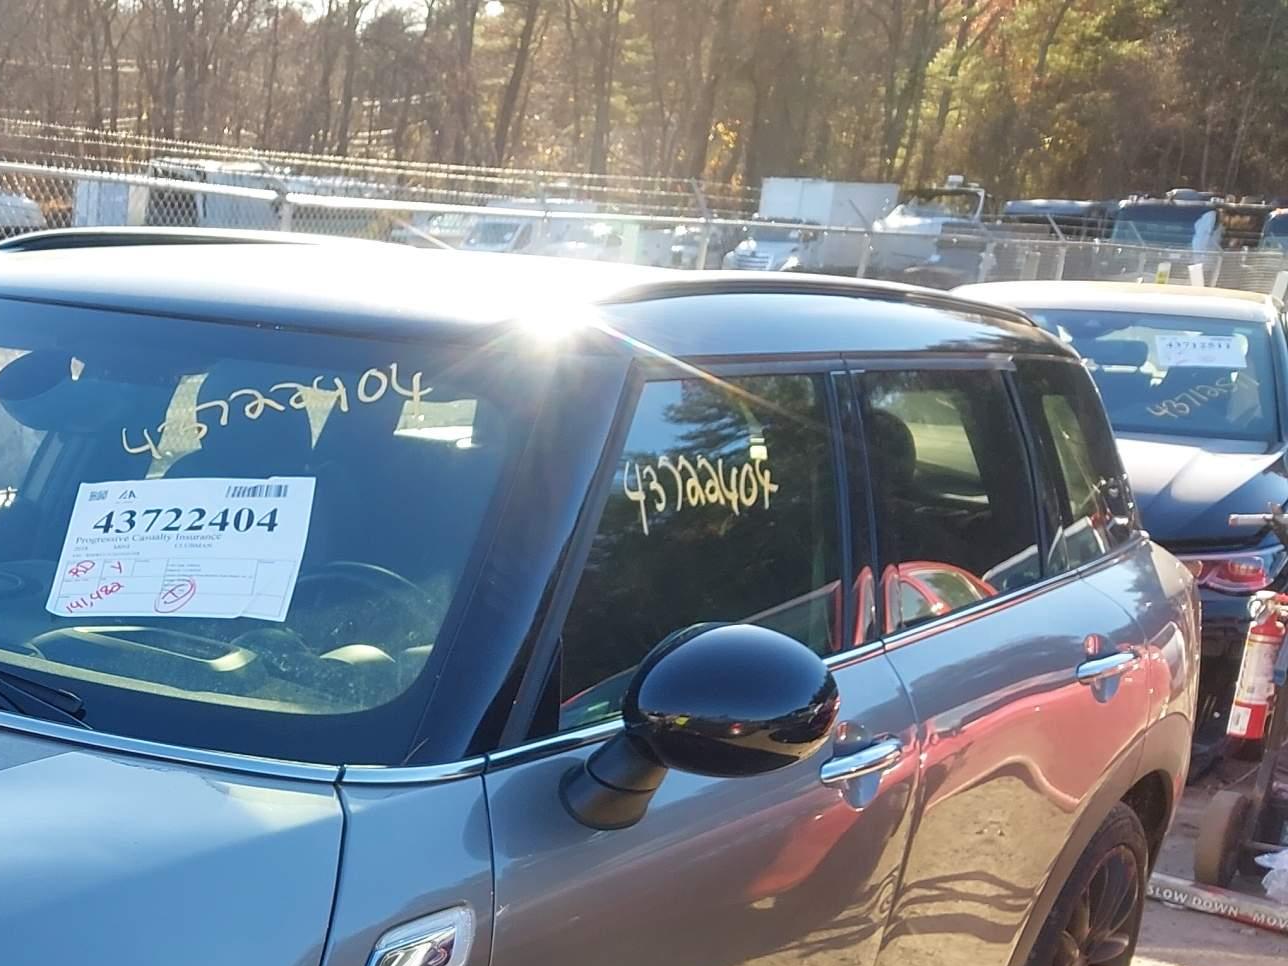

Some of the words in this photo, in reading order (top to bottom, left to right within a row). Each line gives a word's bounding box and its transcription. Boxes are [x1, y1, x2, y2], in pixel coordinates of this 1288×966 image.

[122, 363, 432, 459] 43722404
[624, 454, 779, 536] 43722404
[75, 536, 129, 545] Progressive
[132, 533, 171, 542] Casualty
[175, 533, 221, 541] Insurance
[92, 507, 278, 534] 43722404
[1146, 884, 1188, 903] SLOW
[1192, 896, 1239, 917] DOWN
[1253, 912, 1288, 929] MOV
